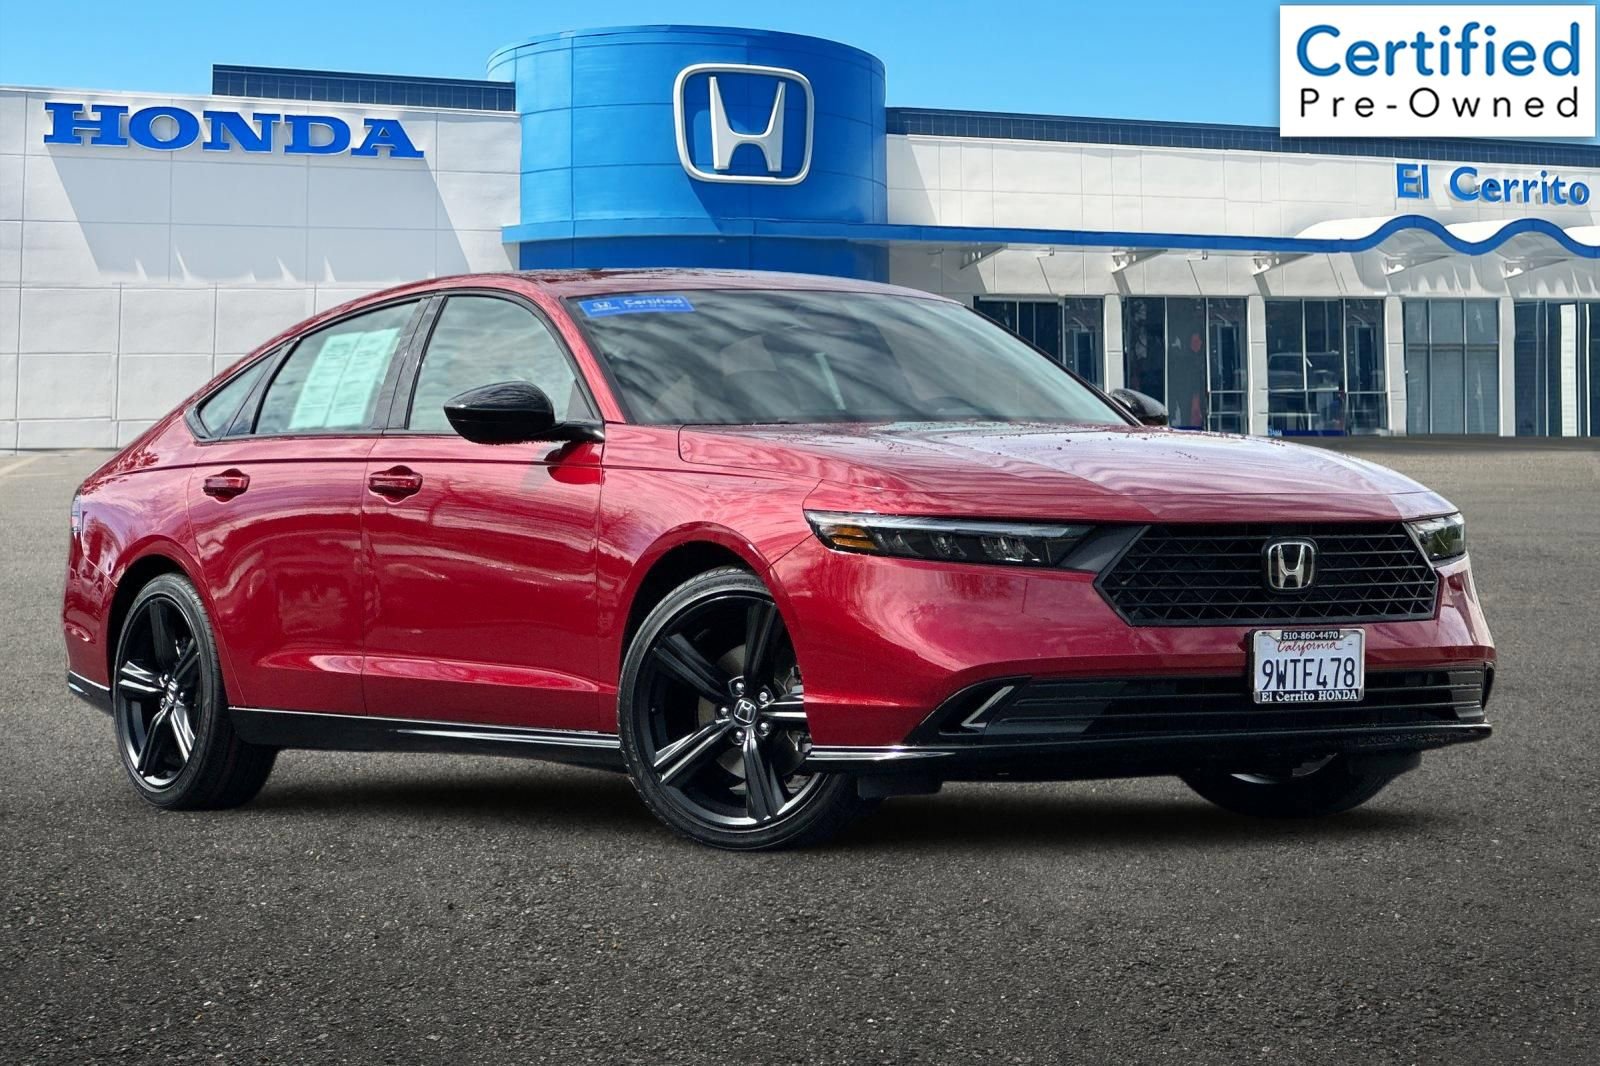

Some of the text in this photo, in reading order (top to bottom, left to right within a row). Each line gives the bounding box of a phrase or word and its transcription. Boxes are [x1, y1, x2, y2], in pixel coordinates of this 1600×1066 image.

[43, 102, 425, 159] HONDA
[1396, 163, 1591, 206] El Cerrito
[1283, 631, 1339, 640] 510-860-4470
[1277, 640, 1343, 656] California
[1262, 657, 1356, 690] 9WTF478
[1261, 690, 1358, 702] El Cerrito HONDA
